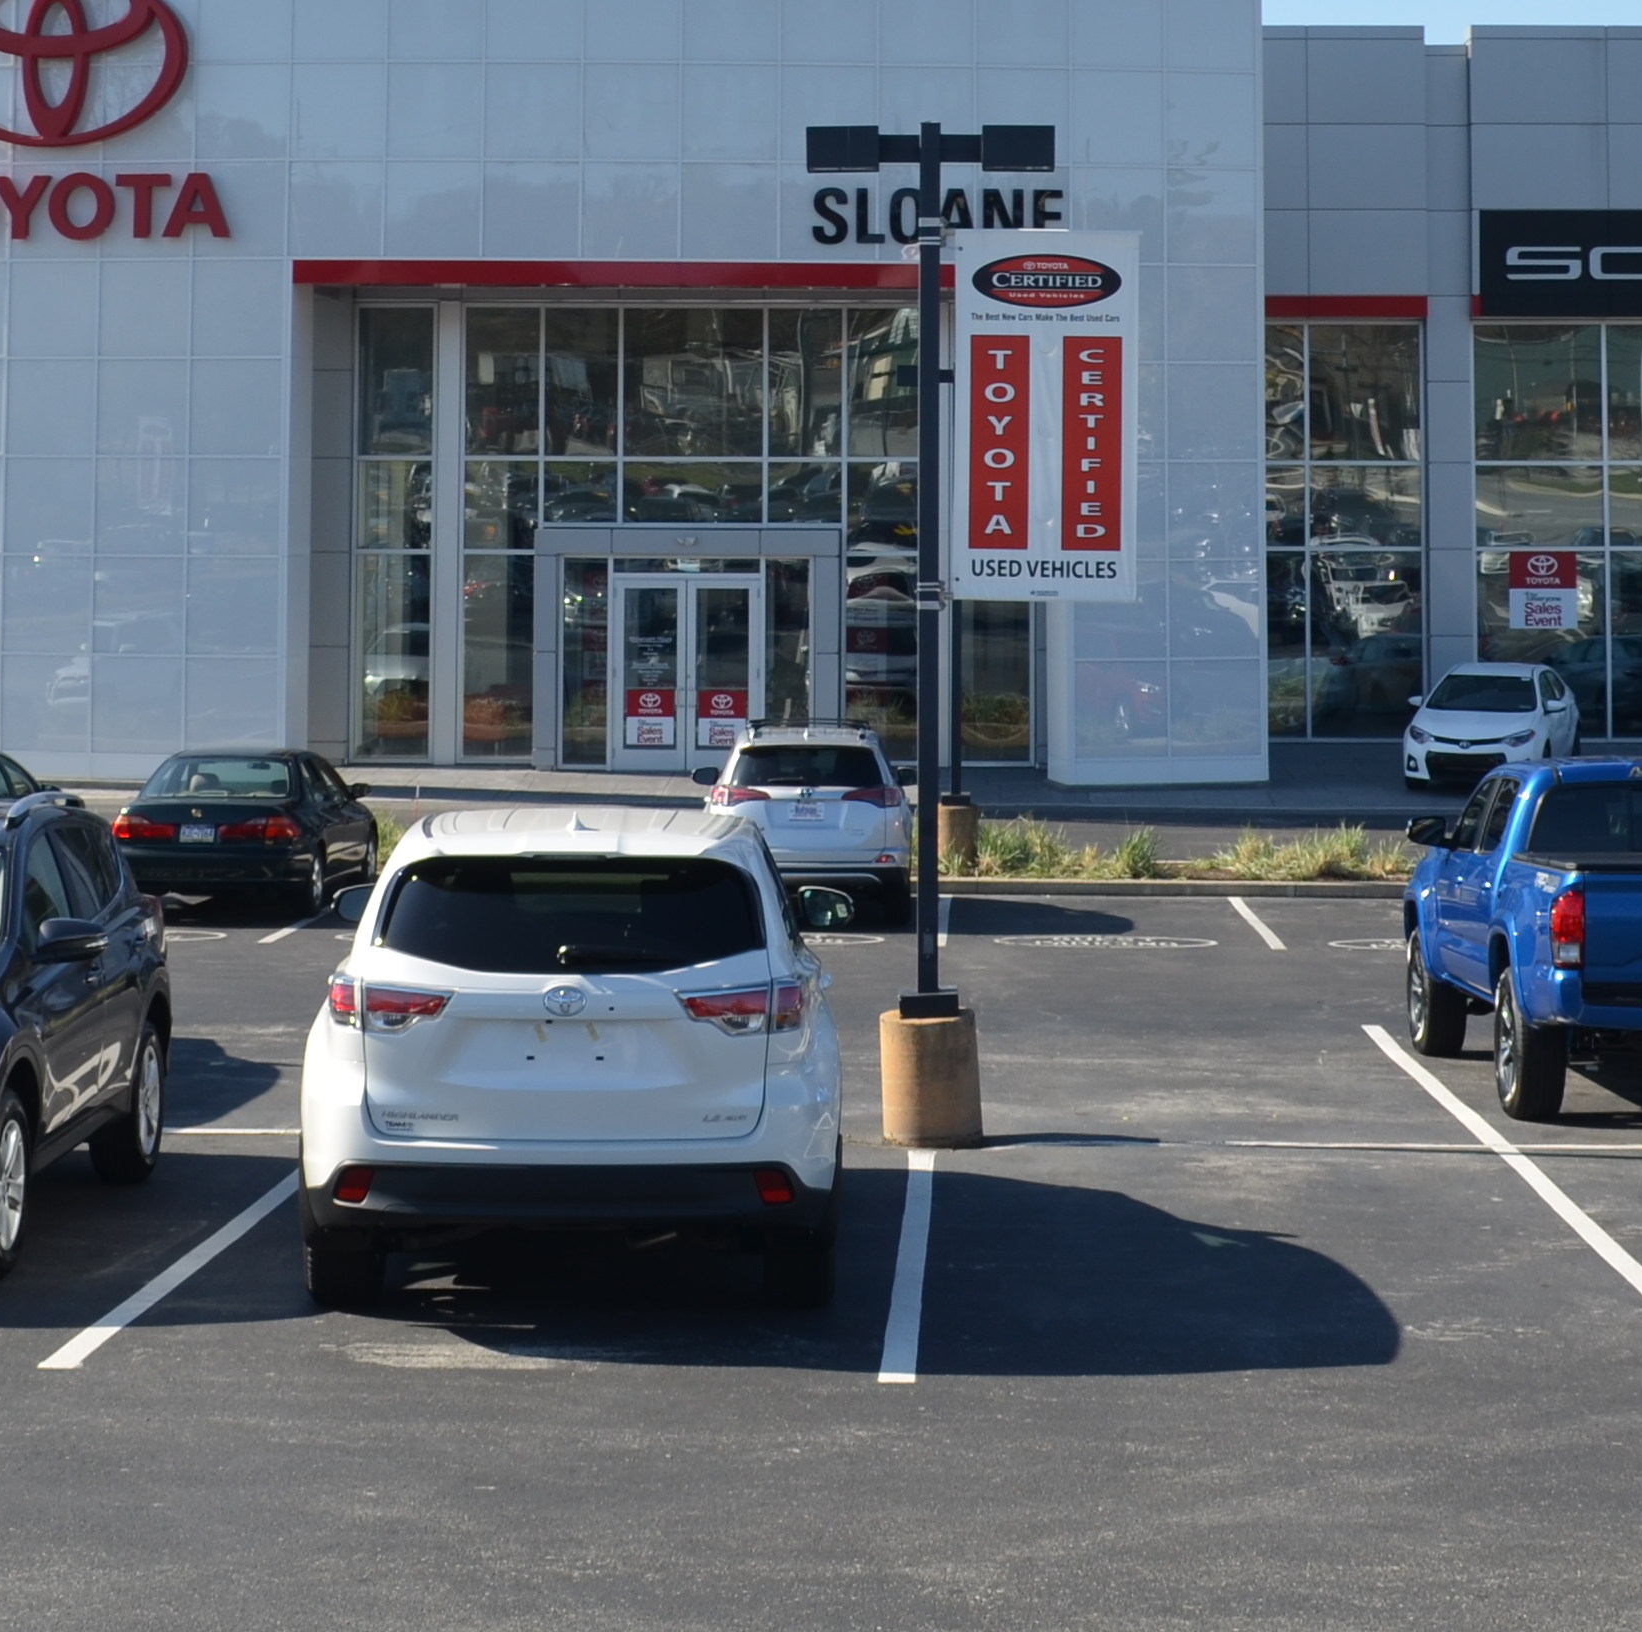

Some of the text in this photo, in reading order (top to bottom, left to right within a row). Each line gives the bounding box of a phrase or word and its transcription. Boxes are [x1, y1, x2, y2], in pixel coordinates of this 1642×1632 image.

[1037, 261, 1069, 270] TOYOTA
[971, 312, 1120, 323] The Best New Cars Make The Best Used Cars
[983, 349, 1016, 535] TOYOTA
[1075, 349, 1106, 538] CERTIFIED
[971, 559, 1117, 579] USED VEHICLES
[1525, 577, 1561, 585] TOYOTA
[1525, 602, 1562, 615] Sales
[1525, 614, 1562, 627] Event
[381, 1111, 459, 1122] HIGHLANDER
